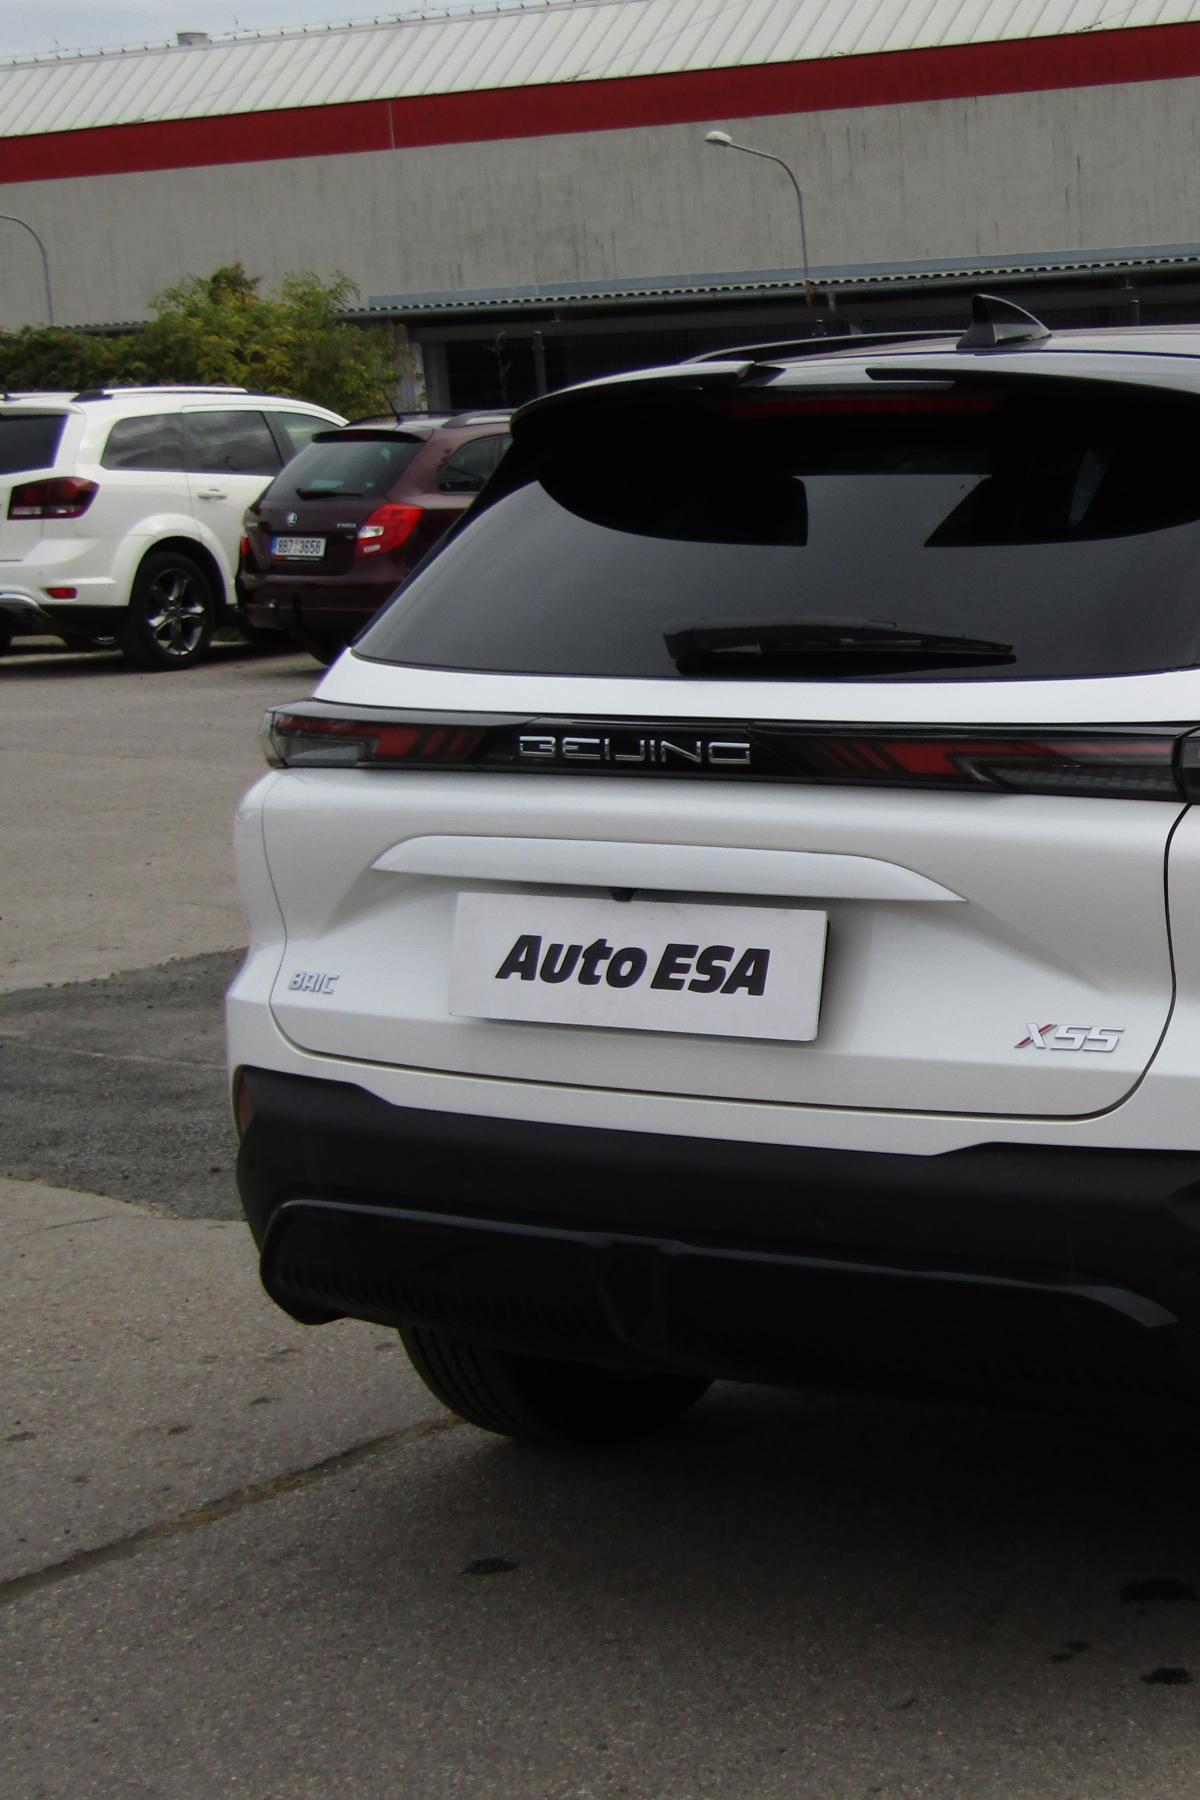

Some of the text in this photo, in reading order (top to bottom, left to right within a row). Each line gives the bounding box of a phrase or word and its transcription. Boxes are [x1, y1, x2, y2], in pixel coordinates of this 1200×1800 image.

[299, 539, 321, 554] 3658
[519, 735, 750, 765] BEIJING
[495, 934, 771, 997] Auto ESA
[288, 970, 340, 995] BAIC
[1014, 1022, 1125, 1053] X55
